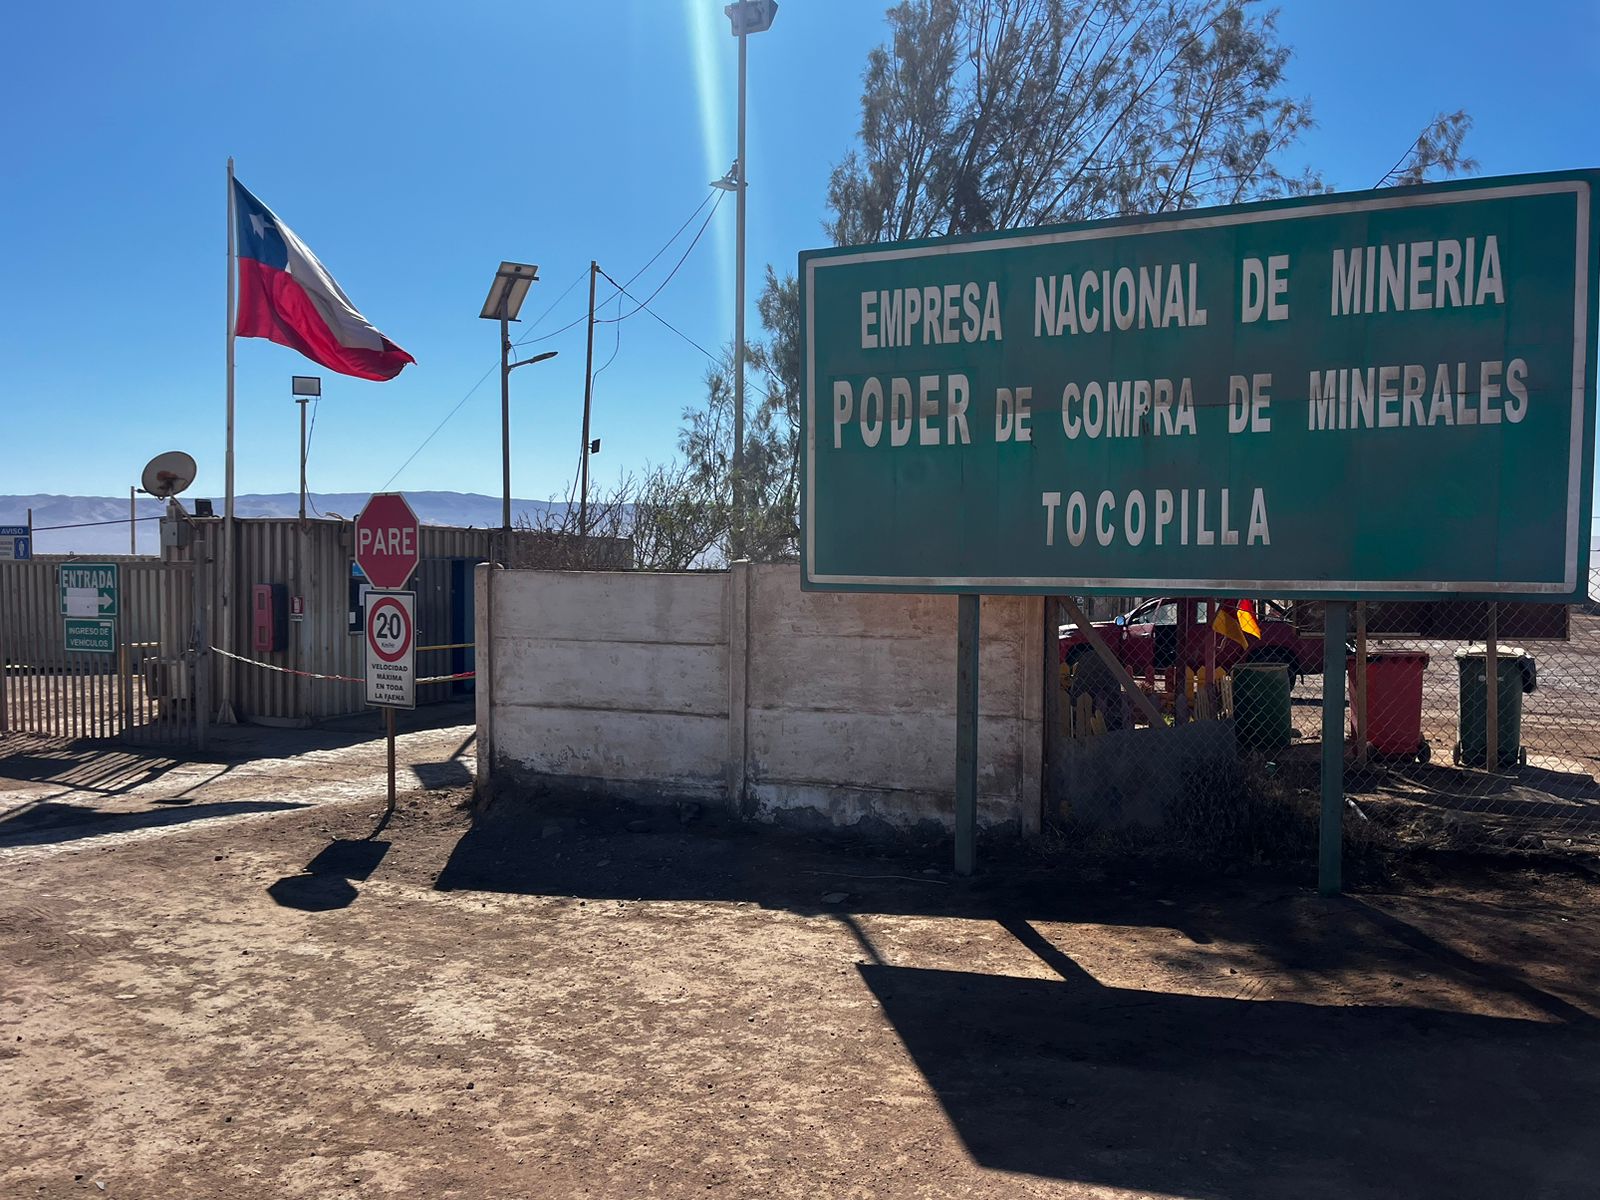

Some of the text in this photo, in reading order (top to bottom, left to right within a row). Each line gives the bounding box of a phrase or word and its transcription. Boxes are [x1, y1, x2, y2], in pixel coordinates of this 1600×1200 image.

[861, 235, 1504, 349] EMPRESA NACIONAL DE MINERIA
[833, 358, 1529, 448] PODER DE COMPRA DE MINERALES
[1042, 487, 1271, 547] TOCOPILLA
[1, 527, 24, 535] AVISO
[359, 527, 415, 556] PARE
[62, 570, 113, 589] ENTRADA
[68, 627, 109, 636] INGRESO DE
[376, 612, 402, 640] 20
[371, 663, 408, 672] VELOCIDAD
[386, 683, 404, 691] TODA
[384, 693, 405, 701] FAENA
